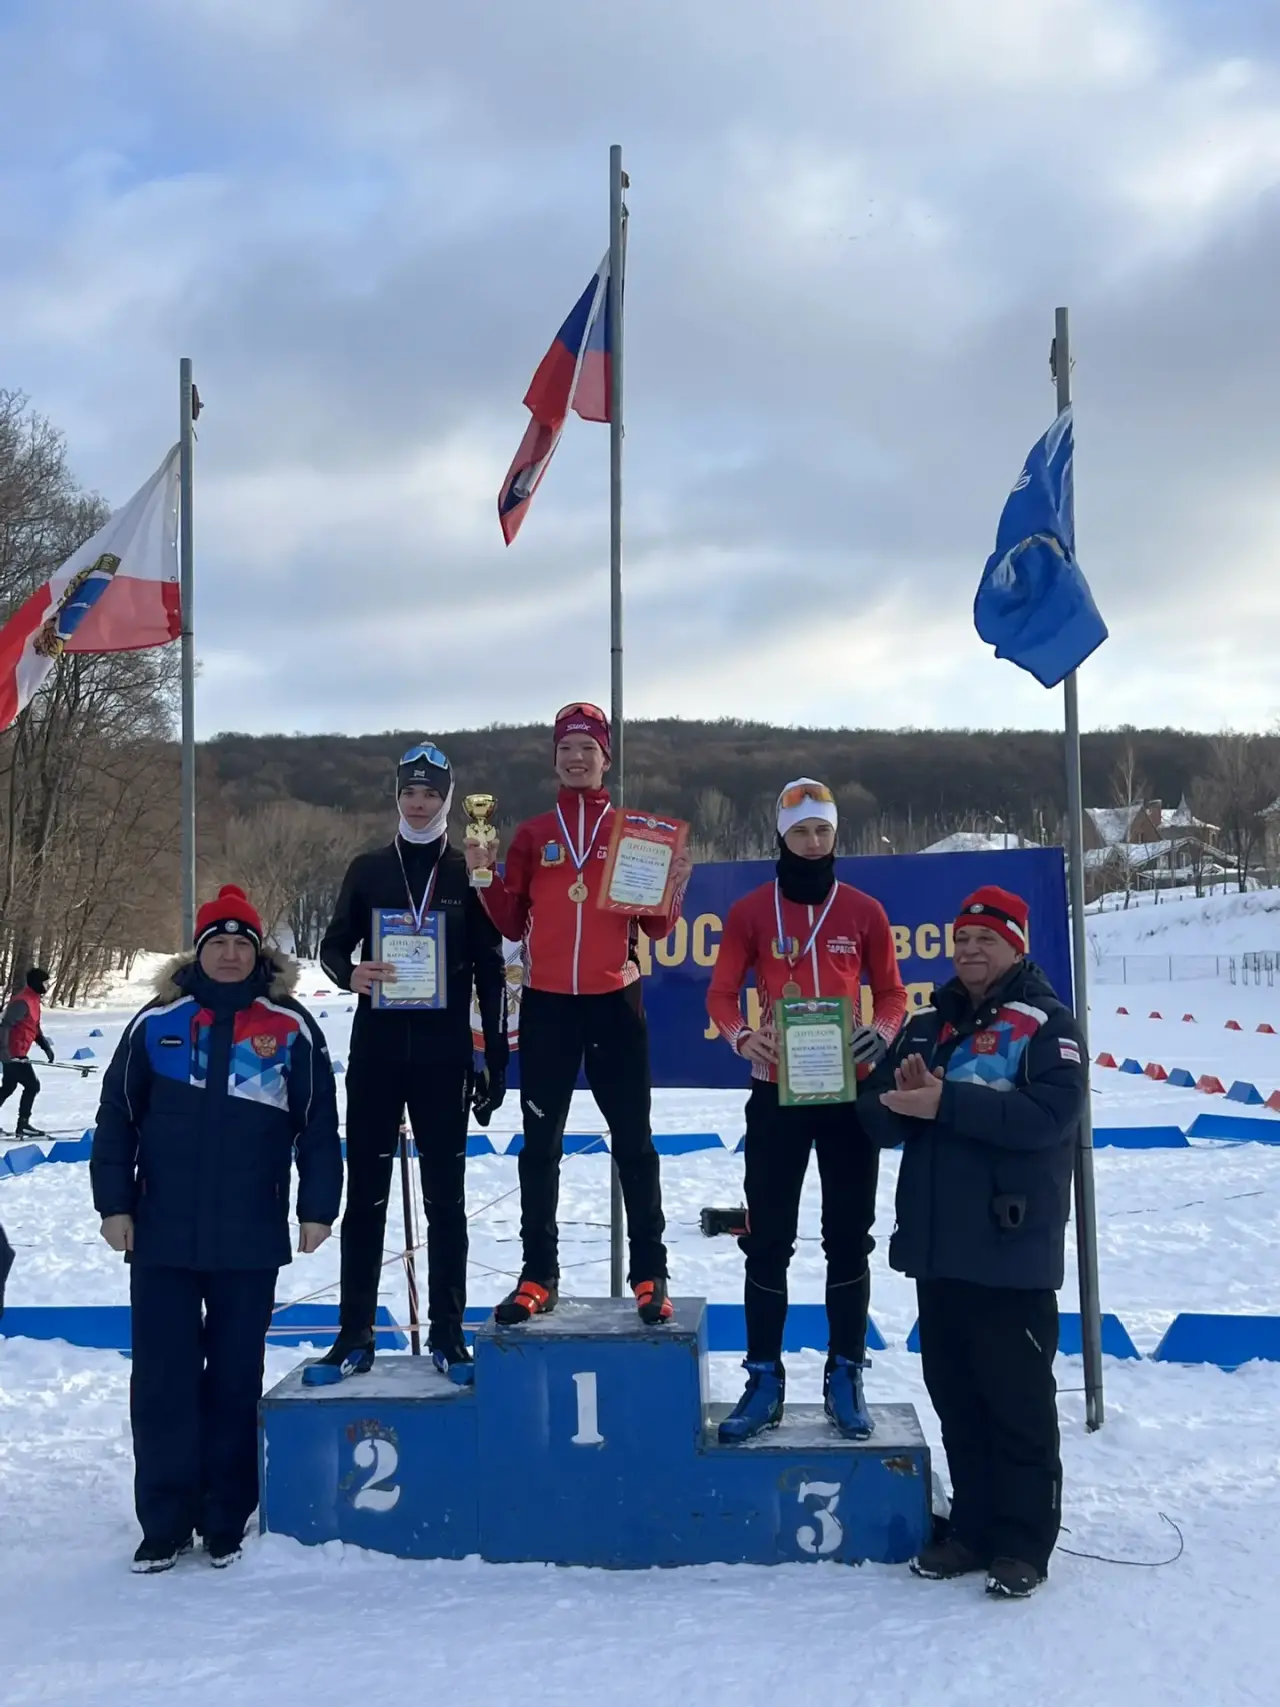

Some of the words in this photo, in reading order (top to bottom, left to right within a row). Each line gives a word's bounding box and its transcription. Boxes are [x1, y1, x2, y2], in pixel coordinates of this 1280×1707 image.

[571, 1371, 604, 1443] 1
[354, 1438, 400, 1512] 2
[796, 1481, 842, 1553] 3
